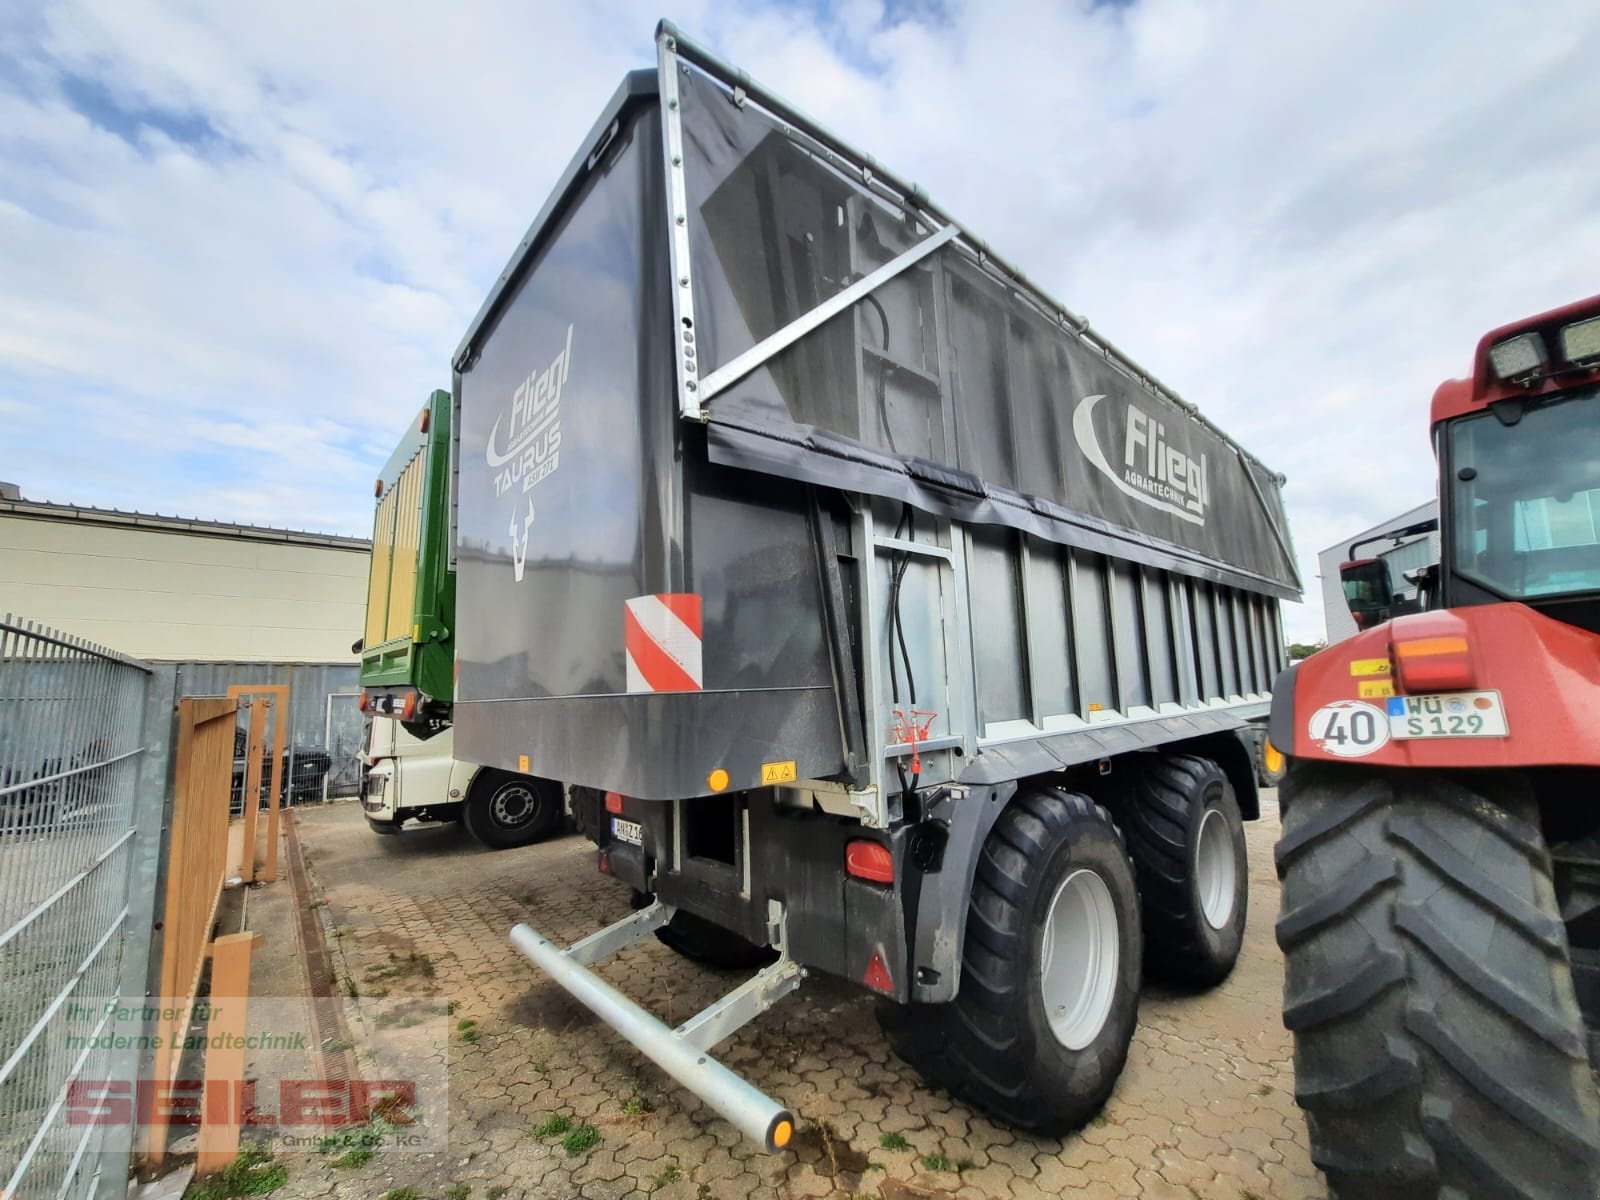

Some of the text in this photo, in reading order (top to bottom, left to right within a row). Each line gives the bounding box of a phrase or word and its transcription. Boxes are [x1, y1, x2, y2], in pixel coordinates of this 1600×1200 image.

[509, 322, 573, 440] Fliegl
[493, 420, 562, 497] TAURUS
[1125, 404, 1208, 515] Fliegl
[1125, 469, 1185, 506] AGRARTECHNIK
[1324, 711, 1376, 745] 40
[1406, 696, 1443, 715] WÜ
